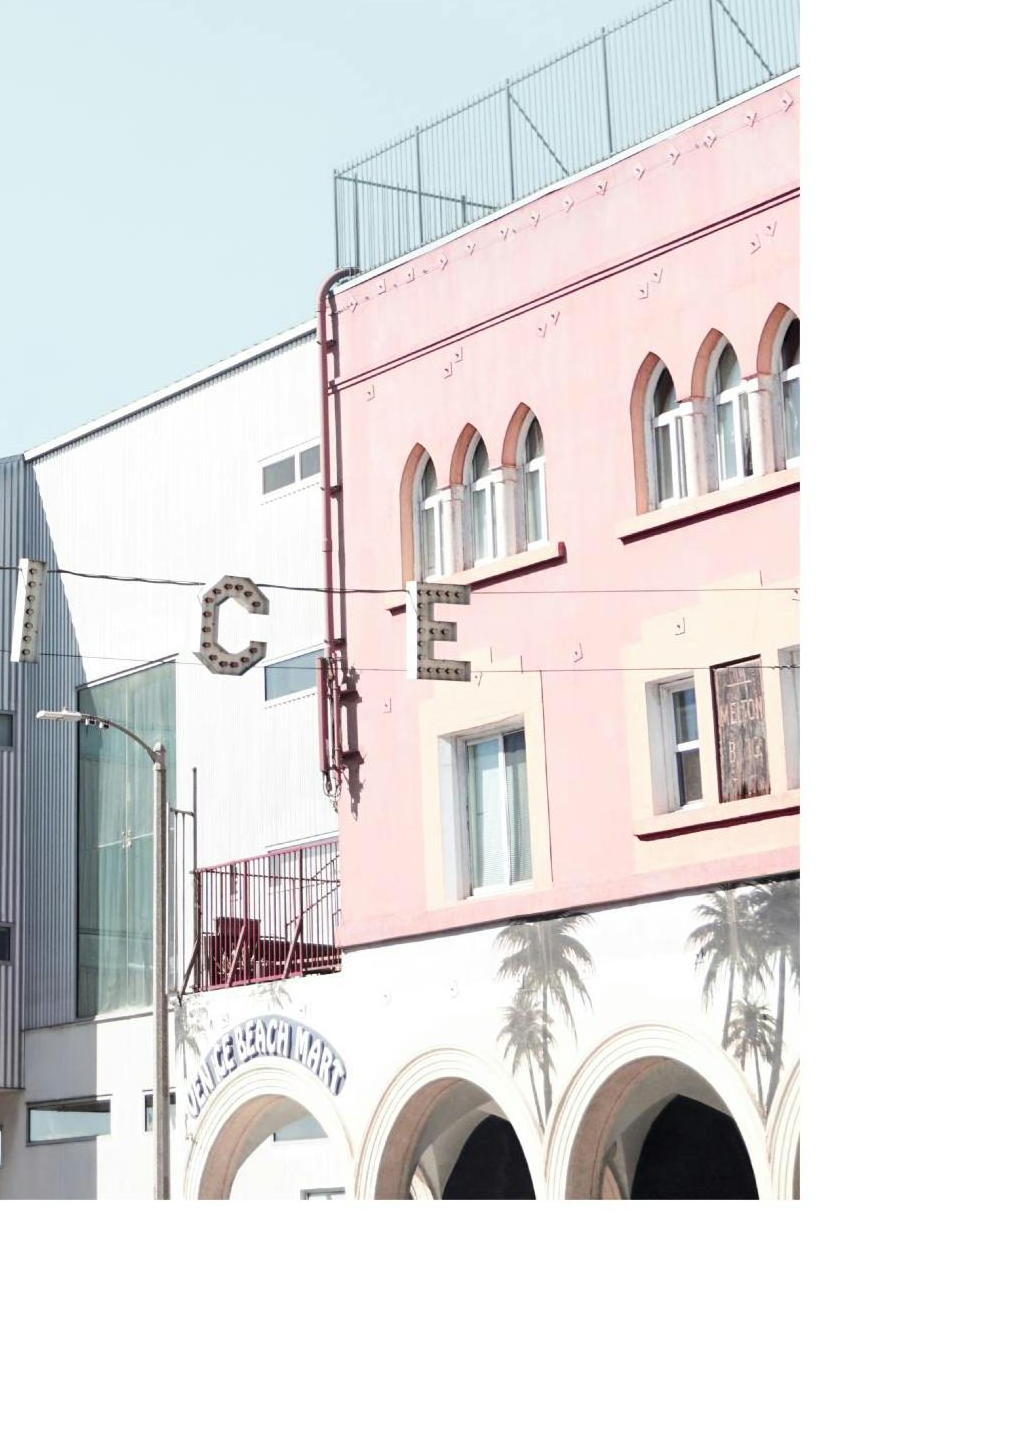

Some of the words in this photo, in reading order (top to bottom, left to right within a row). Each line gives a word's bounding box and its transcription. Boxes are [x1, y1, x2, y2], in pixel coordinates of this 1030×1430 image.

[185, 1033, 238, 1119] VENICE
[234, 1018, 293, 1063] BEACH
[293, 1024, 347, 1097] MART
